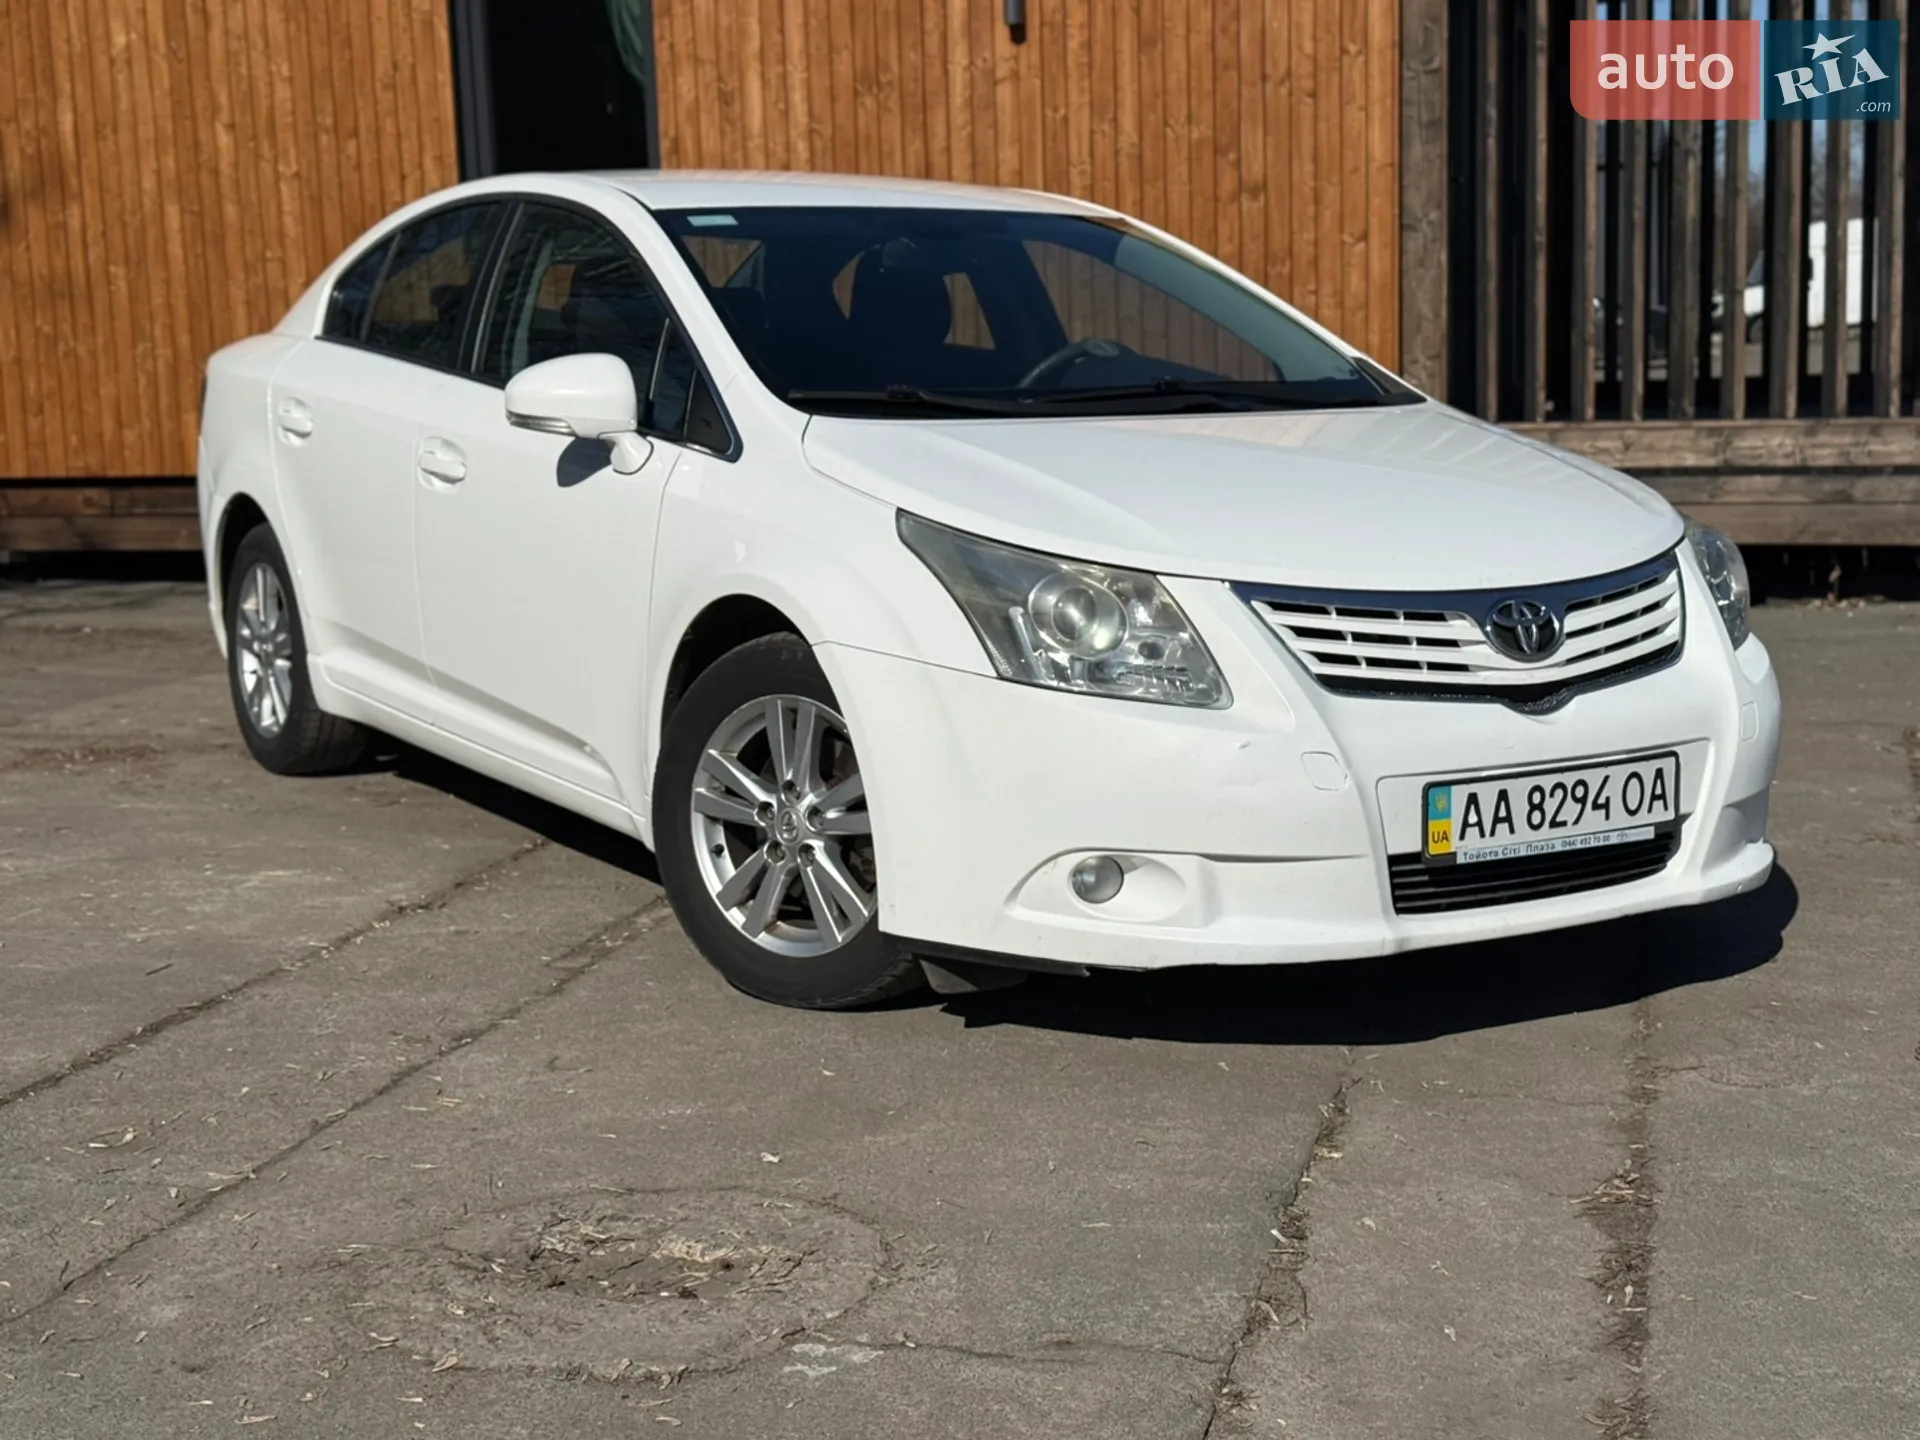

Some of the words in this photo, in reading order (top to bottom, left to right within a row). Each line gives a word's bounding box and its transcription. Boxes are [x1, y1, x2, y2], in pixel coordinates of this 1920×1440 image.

[1459, 788, 1516, 841] AA
[1526, 775, 1612, 832] 8294
[1622, 767, 1669, 817] OA
[1432, 832, 1450, 844] UA
